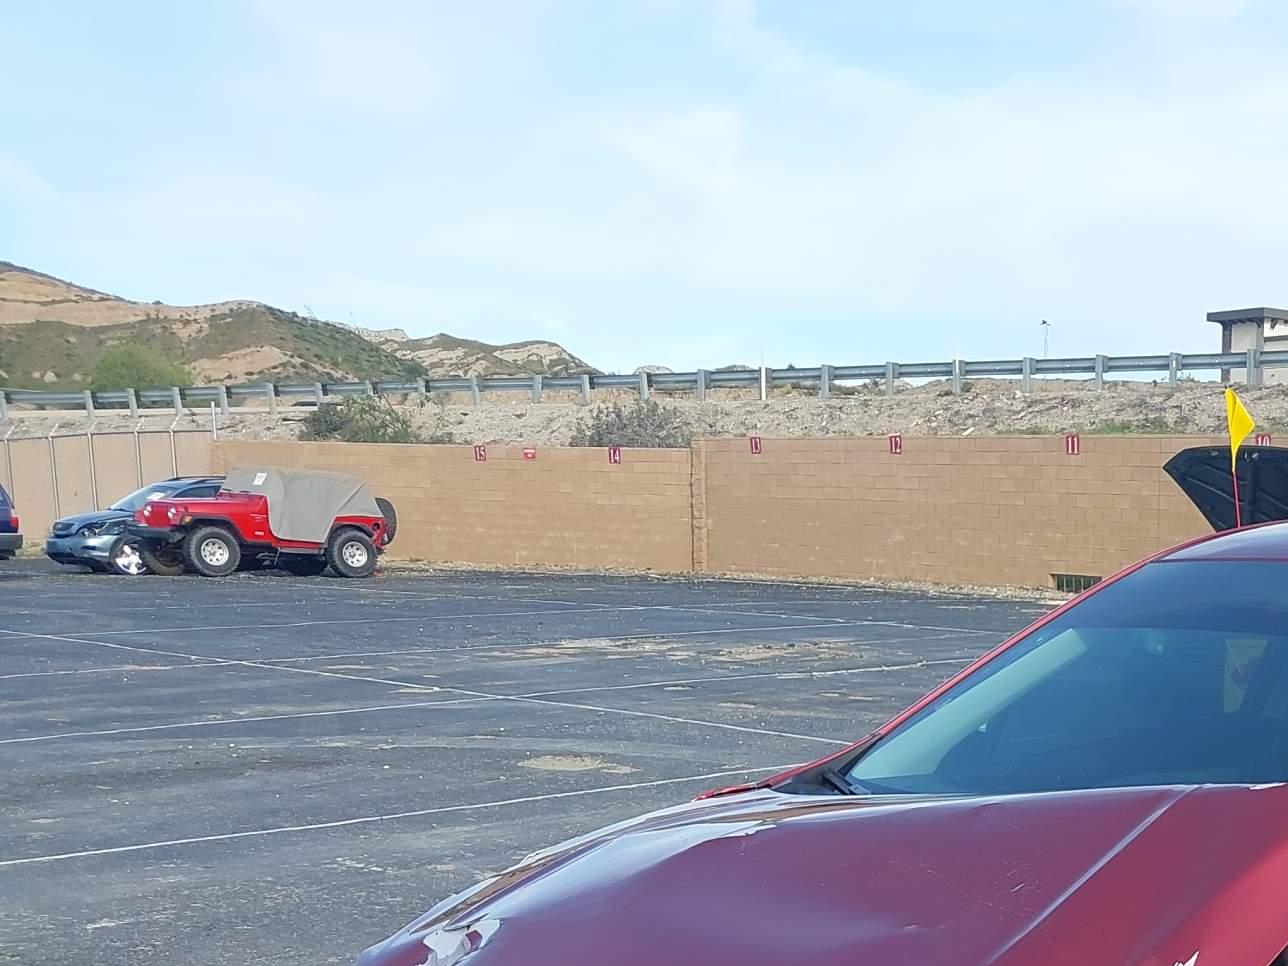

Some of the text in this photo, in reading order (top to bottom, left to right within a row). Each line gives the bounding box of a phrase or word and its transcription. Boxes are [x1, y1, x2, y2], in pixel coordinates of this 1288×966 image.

[752, 438, 761, 453] 13
[891, 437, 901, 453] 12
[1068, 437, 1078, 454] 11
[475, 446, 485, 461] 15
[610, 447, 619, 463] 14
